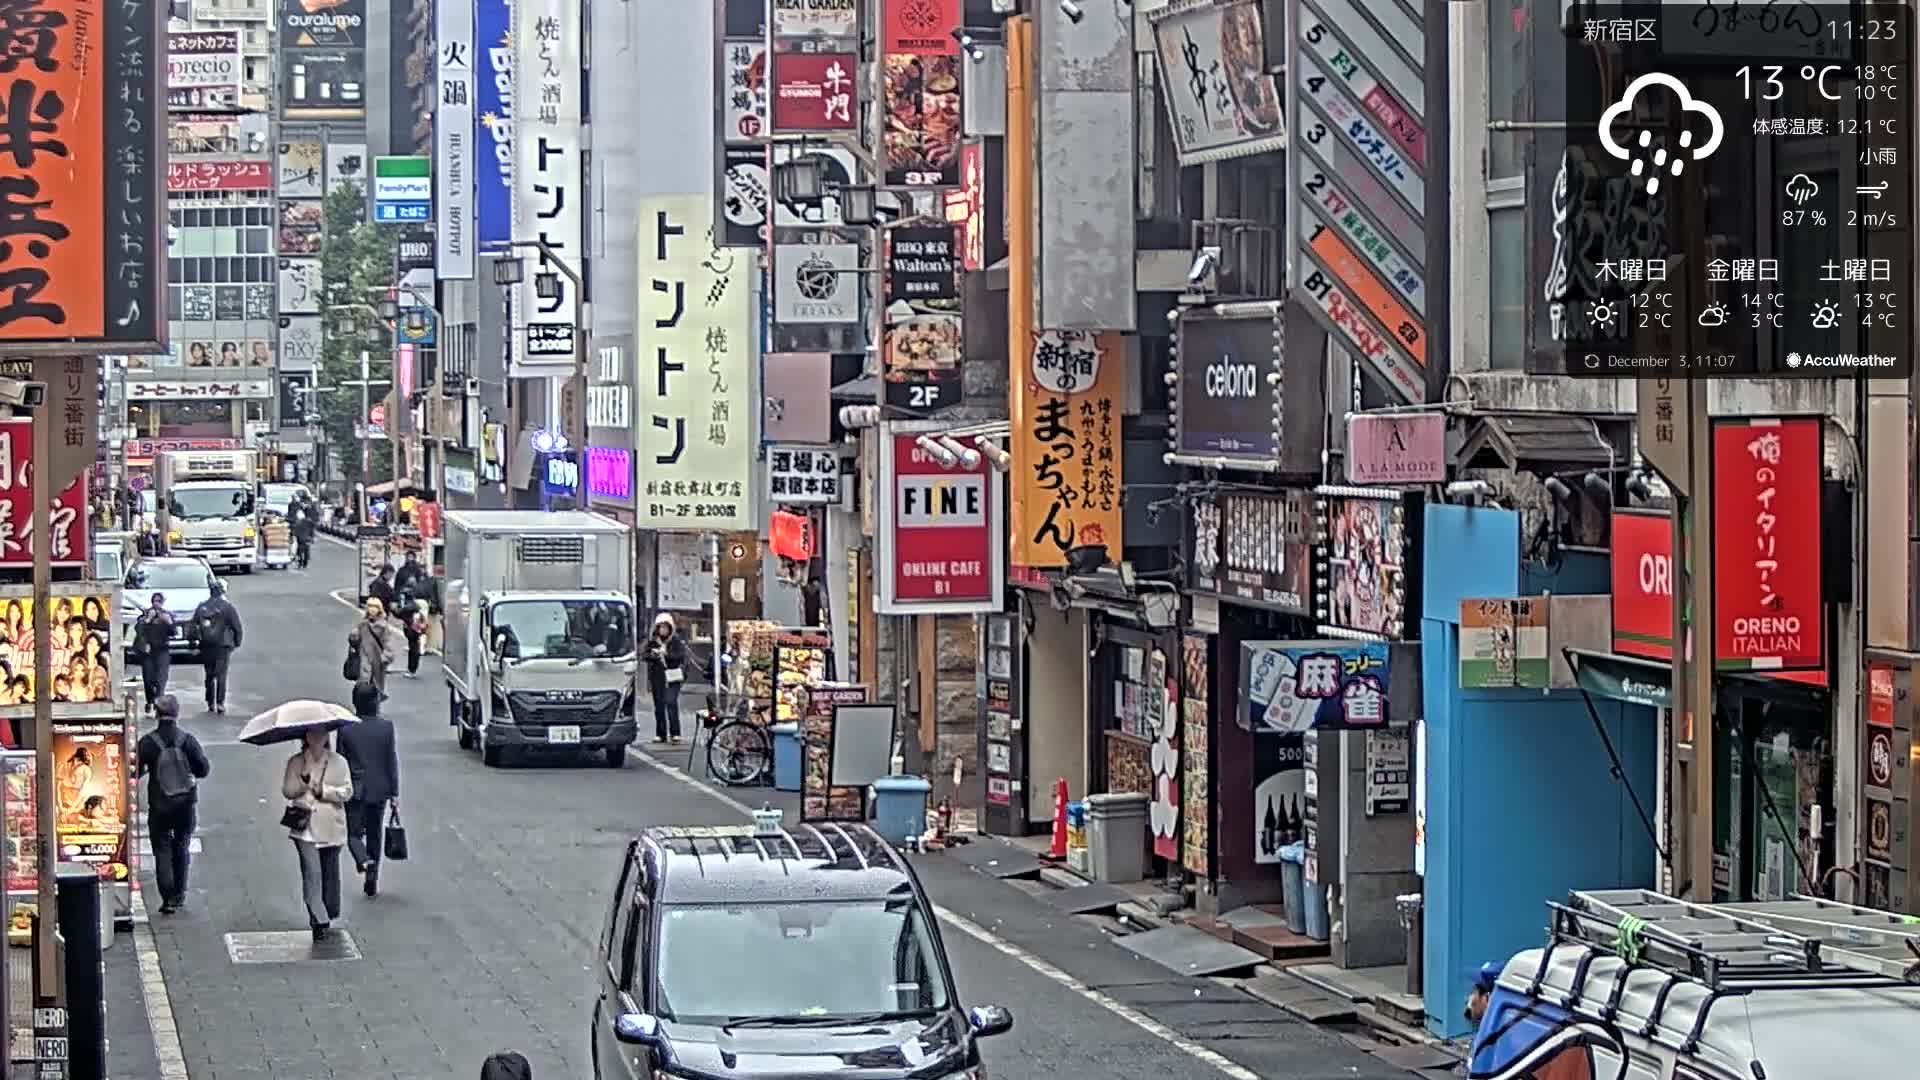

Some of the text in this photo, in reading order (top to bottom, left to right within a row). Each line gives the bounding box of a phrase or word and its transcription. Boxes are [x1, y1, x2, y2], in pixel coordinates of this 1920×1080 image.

[288, 13, 361, 29] auralume
[1307, 24, 1328, 44] 5
[443, 40, 468, 106] 火鍋
[824, 61, 851, 121] 牛門
[1307, 76, 1325, 94] 4
[1307, 123, 1326, 144] 3
[379, 184, 429, 195] FamilyMart
[1306, 174, 1326, 195] 2
[1310, 223, 1325, 243] 1
[894, 257, 952, 272] Walton's
[1304, 271, 1332, 300] B1
[652, 211, 685, 463] トントン
[1206, 355, 1257, 396] celona
[134, 384, 177, 396] コーヒー
[209, 384, 241, 397] クール
[909, 387, 939, 406] 2F
[1384, 424, 1406, 451] A
[772, 452, 835, 473] 酒場心
[1396, 462, 1437, 473] MODE
[1033, 397, 1078, 551] まっちゃん
[772, 477, 836, 495] 新宿本店
[904, 486, 979, 514] FINE
[1747, 432, 1781, 606] 俺のイタリアン
[903, 561, 981, 577] ONLINE CAFE
[935, 581, 951, 594] B1
[1733, 618, 1801, 636] ORENO
[1733, 636, 1801, 654] ITALIAN
[1345, 656, 1383, 674] フリー
[1298, 656, 1385, 725] 麻雀
[34, 1008, 65, 1028] NERO
[37, 1040, 67, 1057] NERO
